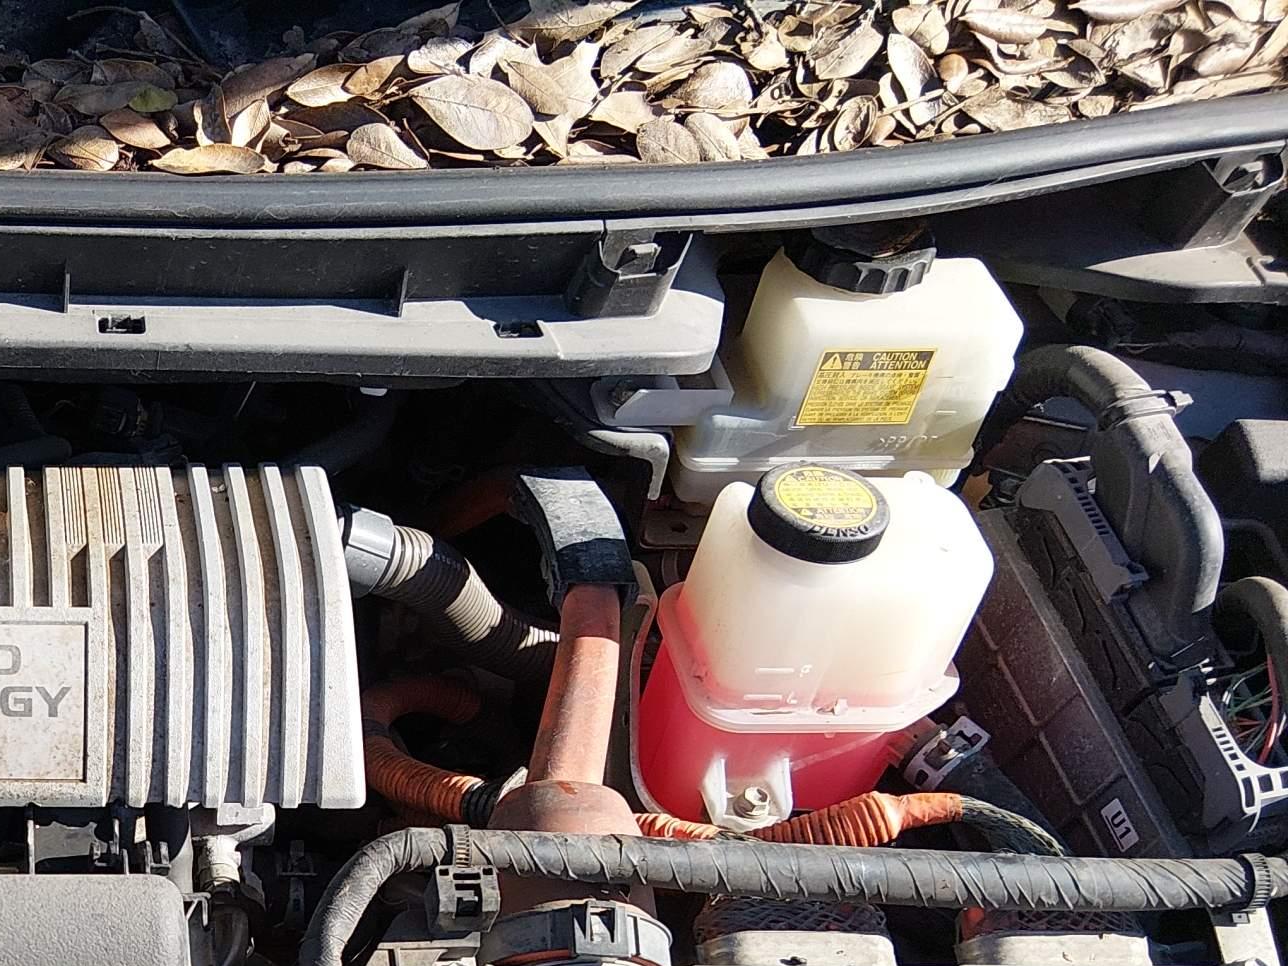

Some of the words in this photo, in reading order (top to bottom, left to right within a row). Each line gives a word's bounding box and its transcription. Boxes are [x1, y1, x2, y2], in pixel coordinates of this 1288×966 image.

[873, 352, 918, 361] CAUTION
[870, 360, 927, 370] ATTENTION
[807, 524, 869, 538] DENSO
[1110, 809, 1132, 840] U1
